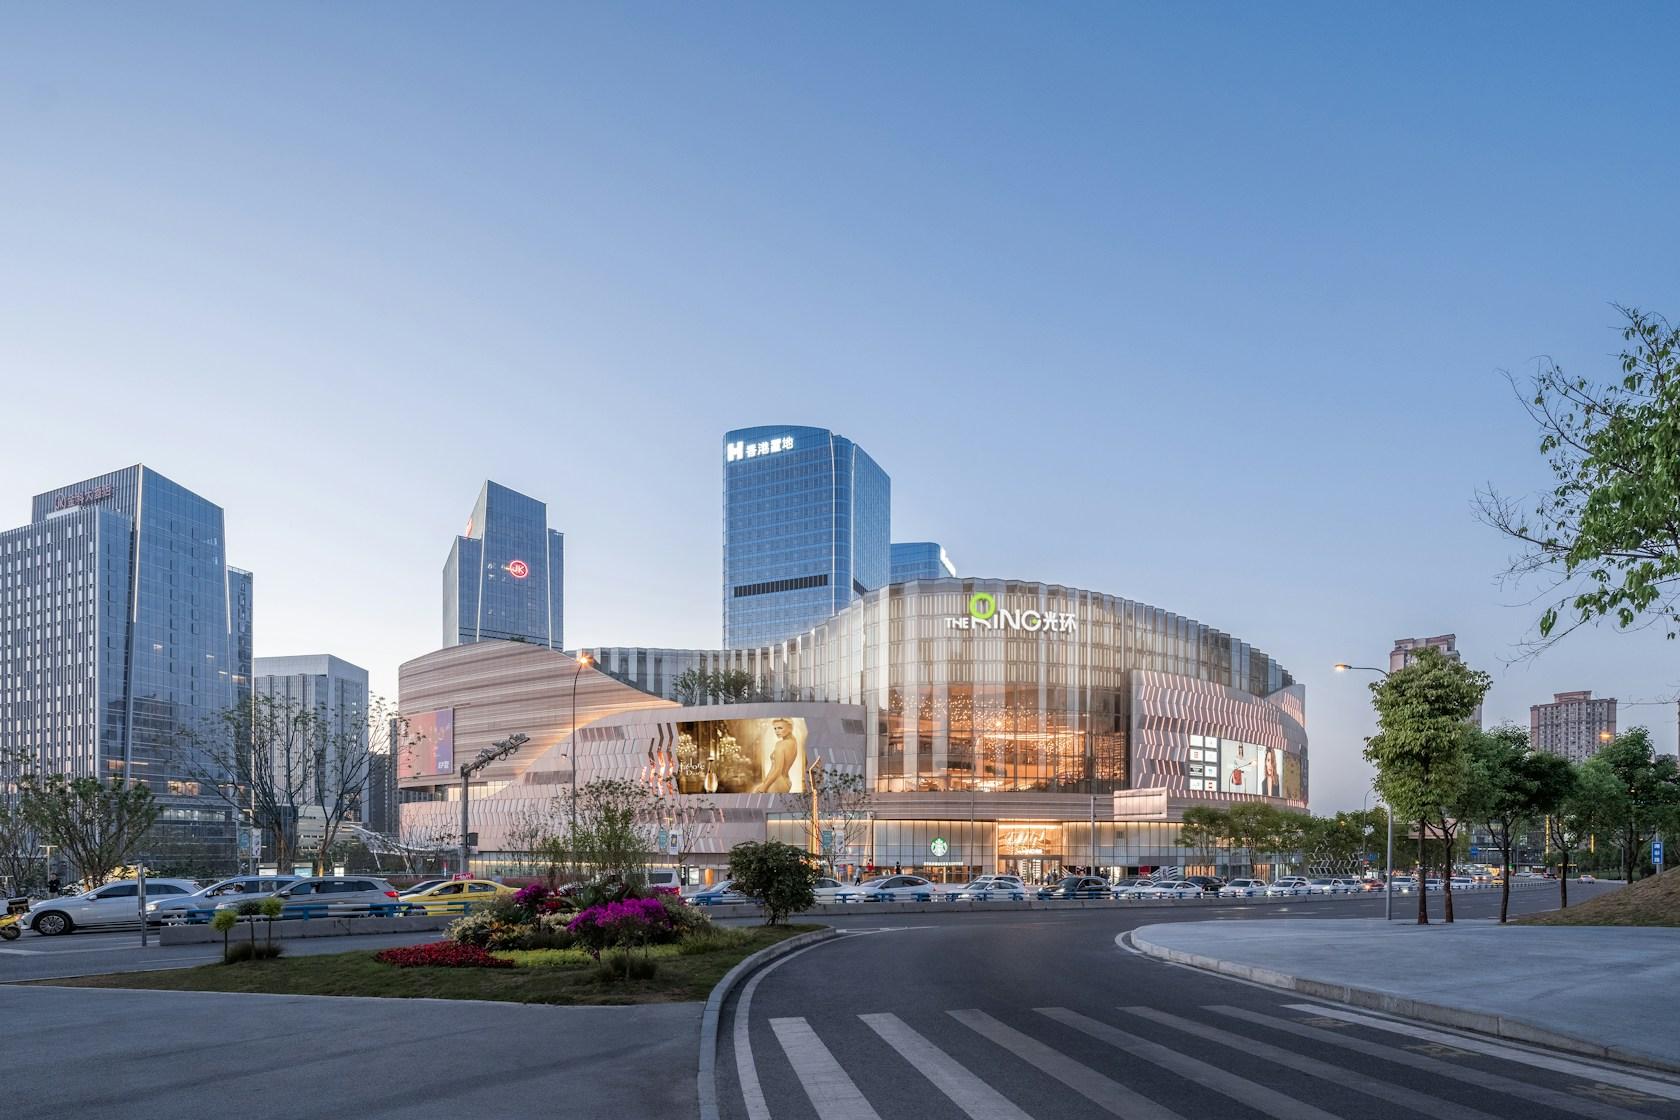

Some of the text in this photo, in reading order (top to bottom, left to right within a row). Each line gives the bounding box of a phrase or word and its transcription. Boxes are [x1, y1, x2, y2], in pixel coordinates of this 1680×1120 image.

[746, 436, 794, 459] 香港置地
[944, 592, 1077, 633] THE RING 光环
